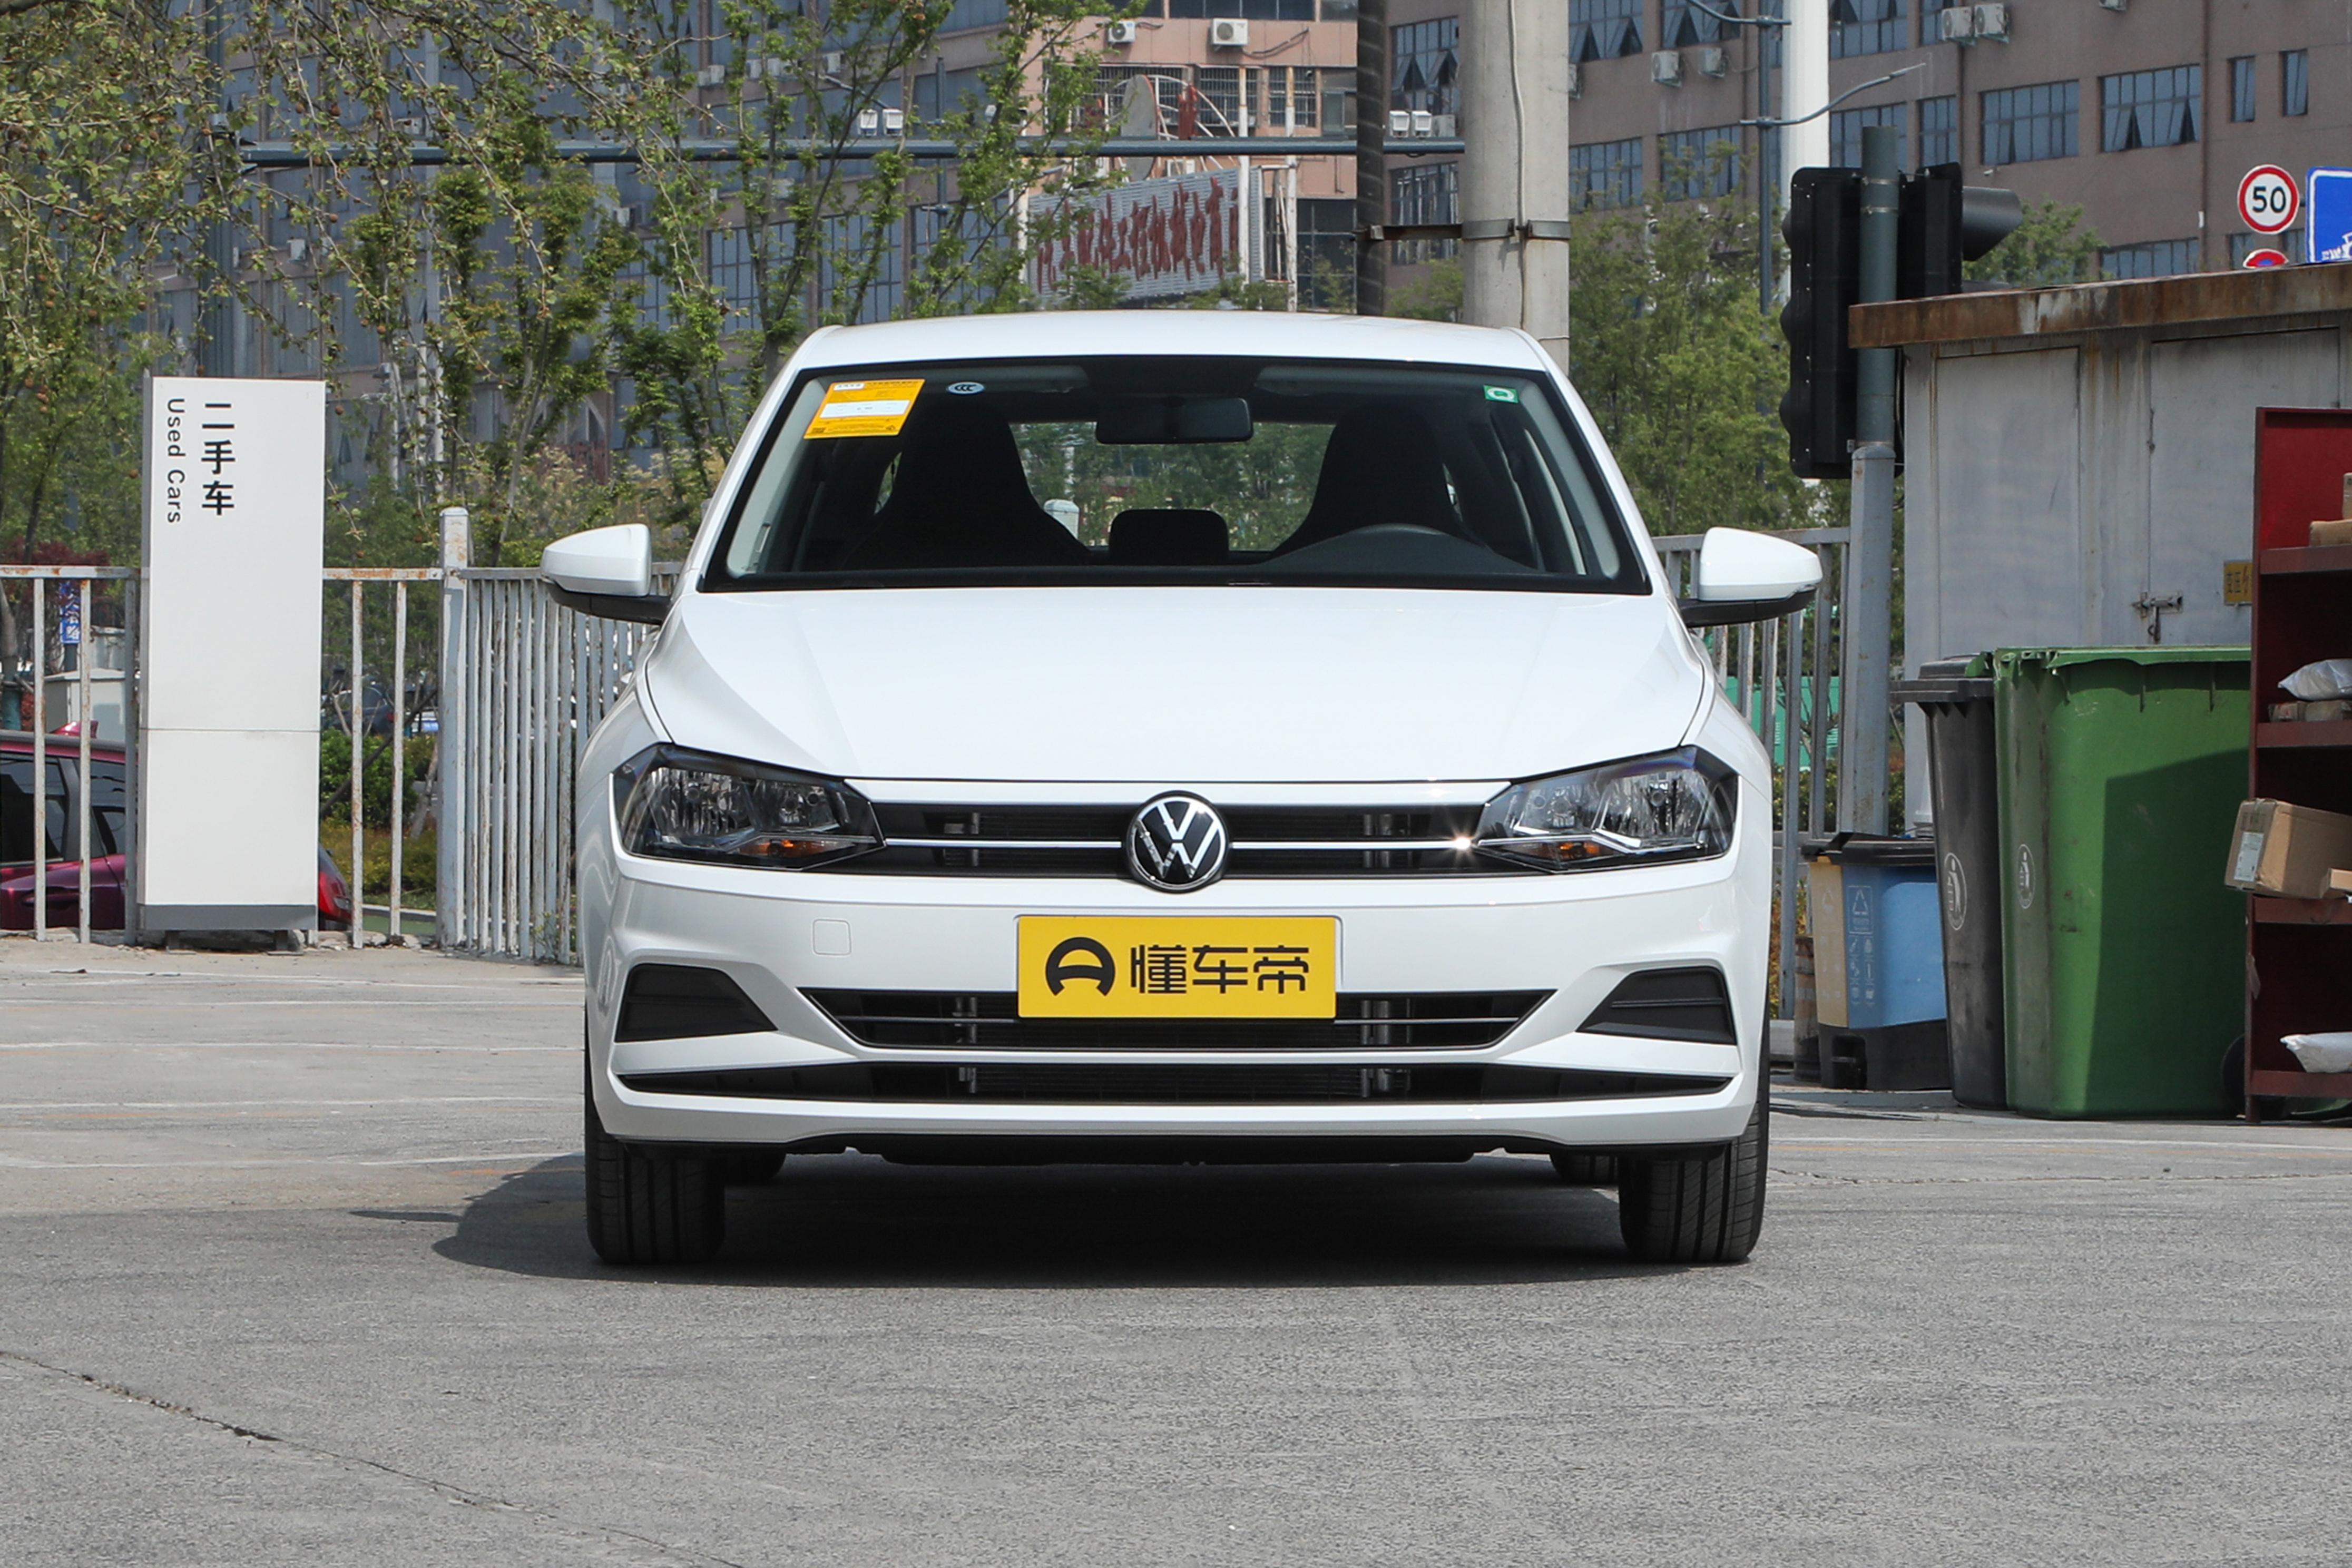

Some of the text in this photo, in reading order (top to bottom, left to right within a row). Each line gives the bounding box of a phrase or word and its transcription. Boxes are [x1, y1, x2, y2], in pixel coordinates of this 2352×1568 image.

[2252, 186, 2286, 213] 50
[167, 398, 186, 523] Used Cars
[201, 403, 236, 516] 二手车
[1130, 945, 1310, 994] 懂车帝
